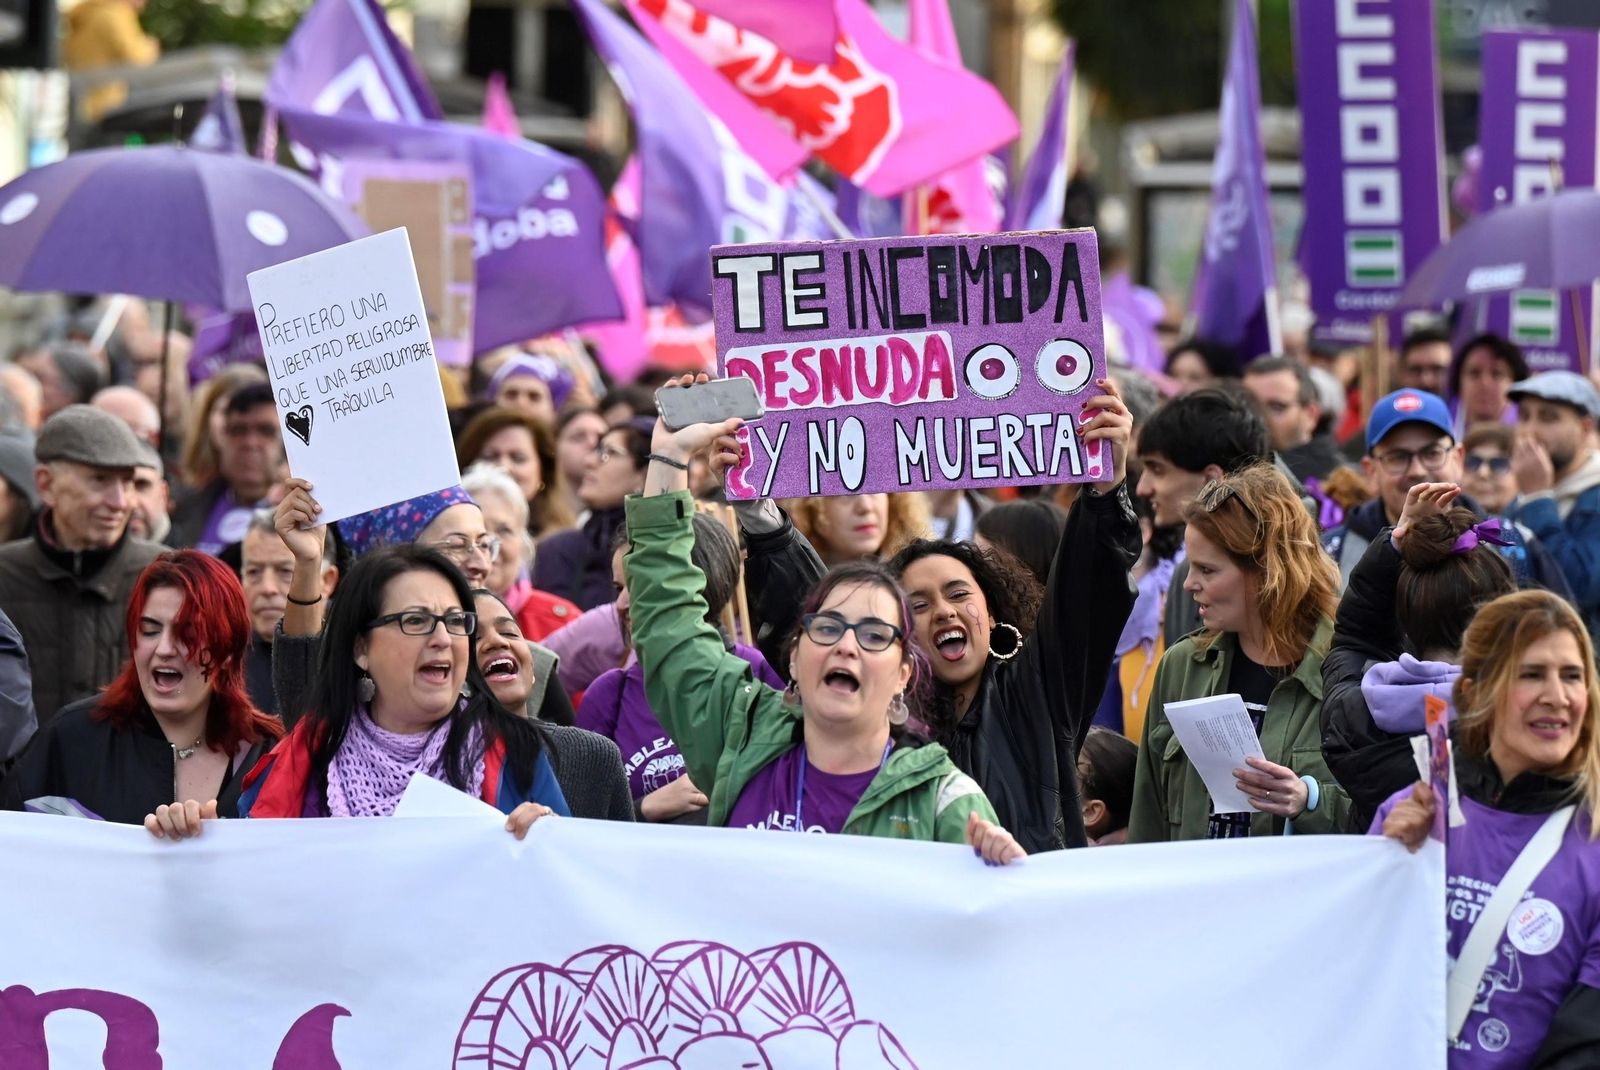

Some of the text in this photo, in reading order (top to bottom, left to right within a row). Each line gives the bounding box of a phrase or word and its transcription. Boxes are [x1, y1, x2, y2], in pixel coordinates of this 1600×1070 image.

[1336, 0, 1400, 225] CCOO
[258, 292, 388, 347] PREFIERO UNA
[713, 242, 1089, 333] TE INCOMODA
[269, 313, 421, 380] LIBERTAD PELIGROSA
[726, 334, 955, 409] DESNUDA
[278, 381, 311, 408] QUE
[315, 367, 349, 395] UNA
[808, 414, 867, 495] NO
